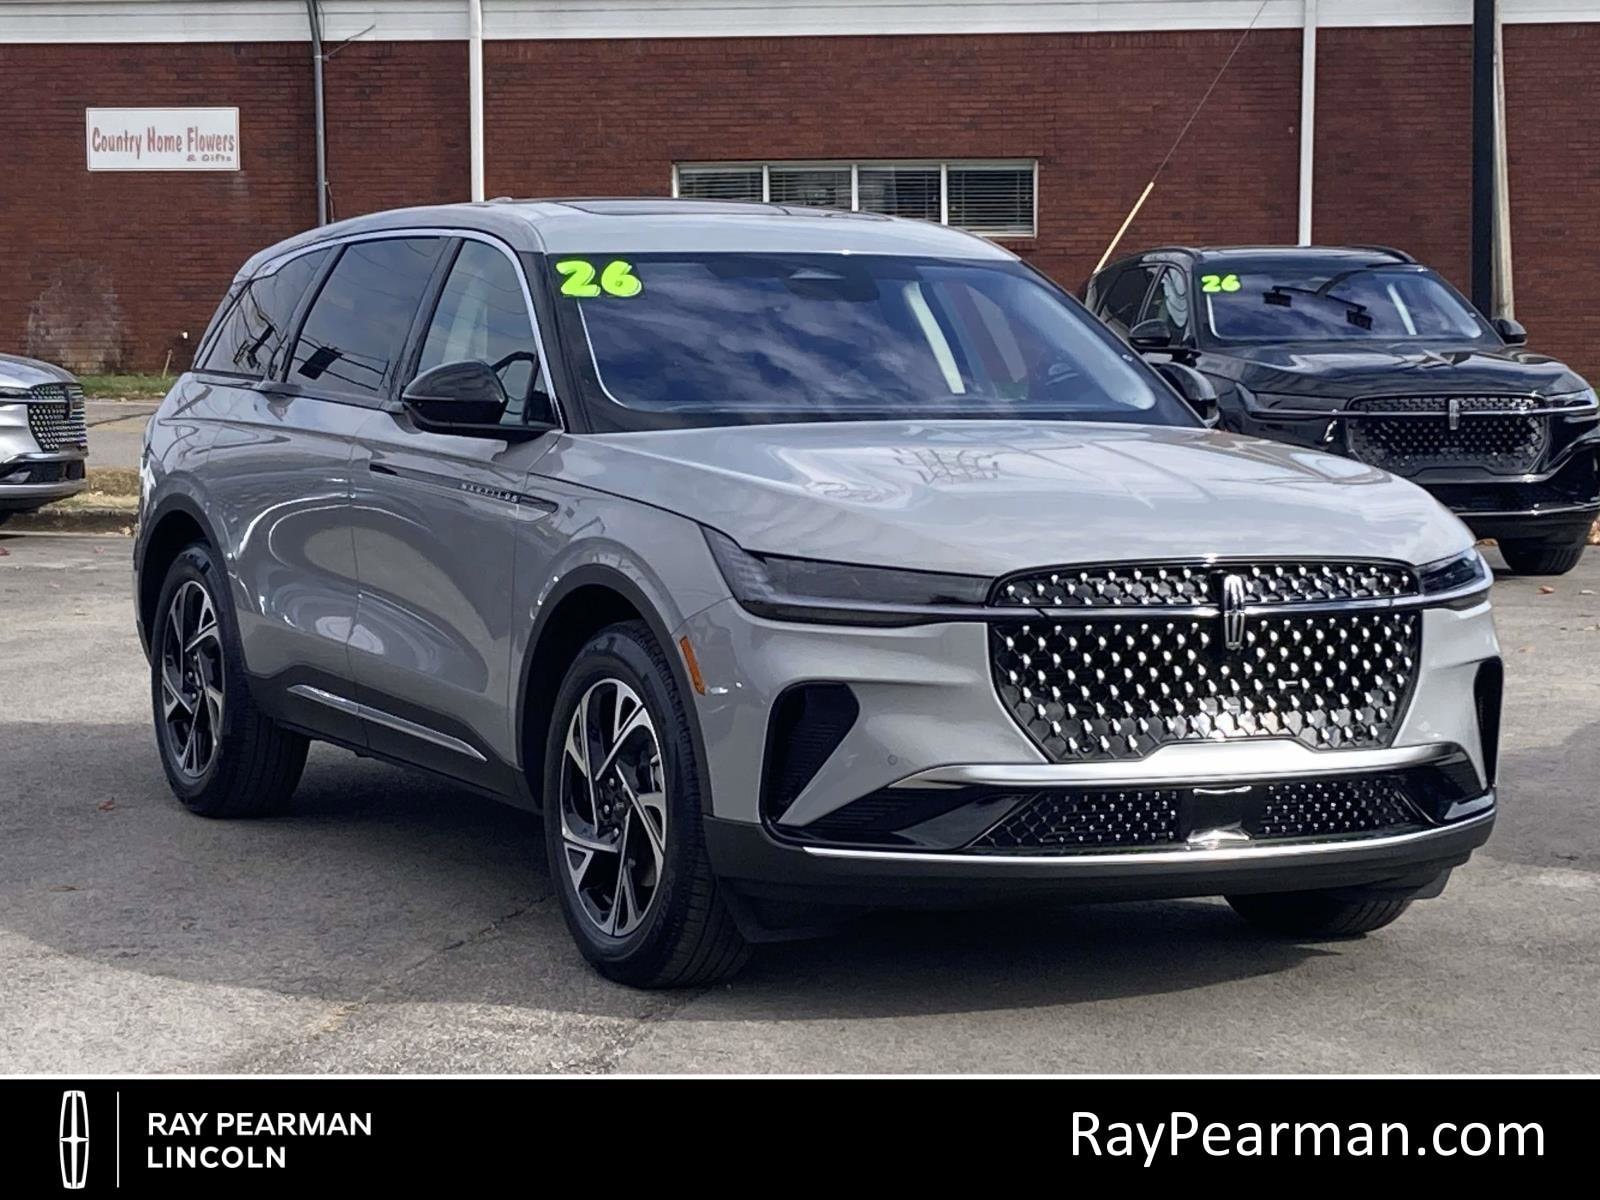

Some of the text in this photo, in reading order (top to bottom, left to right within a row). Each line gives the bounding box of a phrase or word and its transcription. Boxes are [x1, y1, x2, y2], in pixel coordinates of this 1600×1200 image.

[92, 126, 234, 160] Country Home Flowers
[555, 260, 642, 297] 26
[1201, 274, 1241, 292] 26
